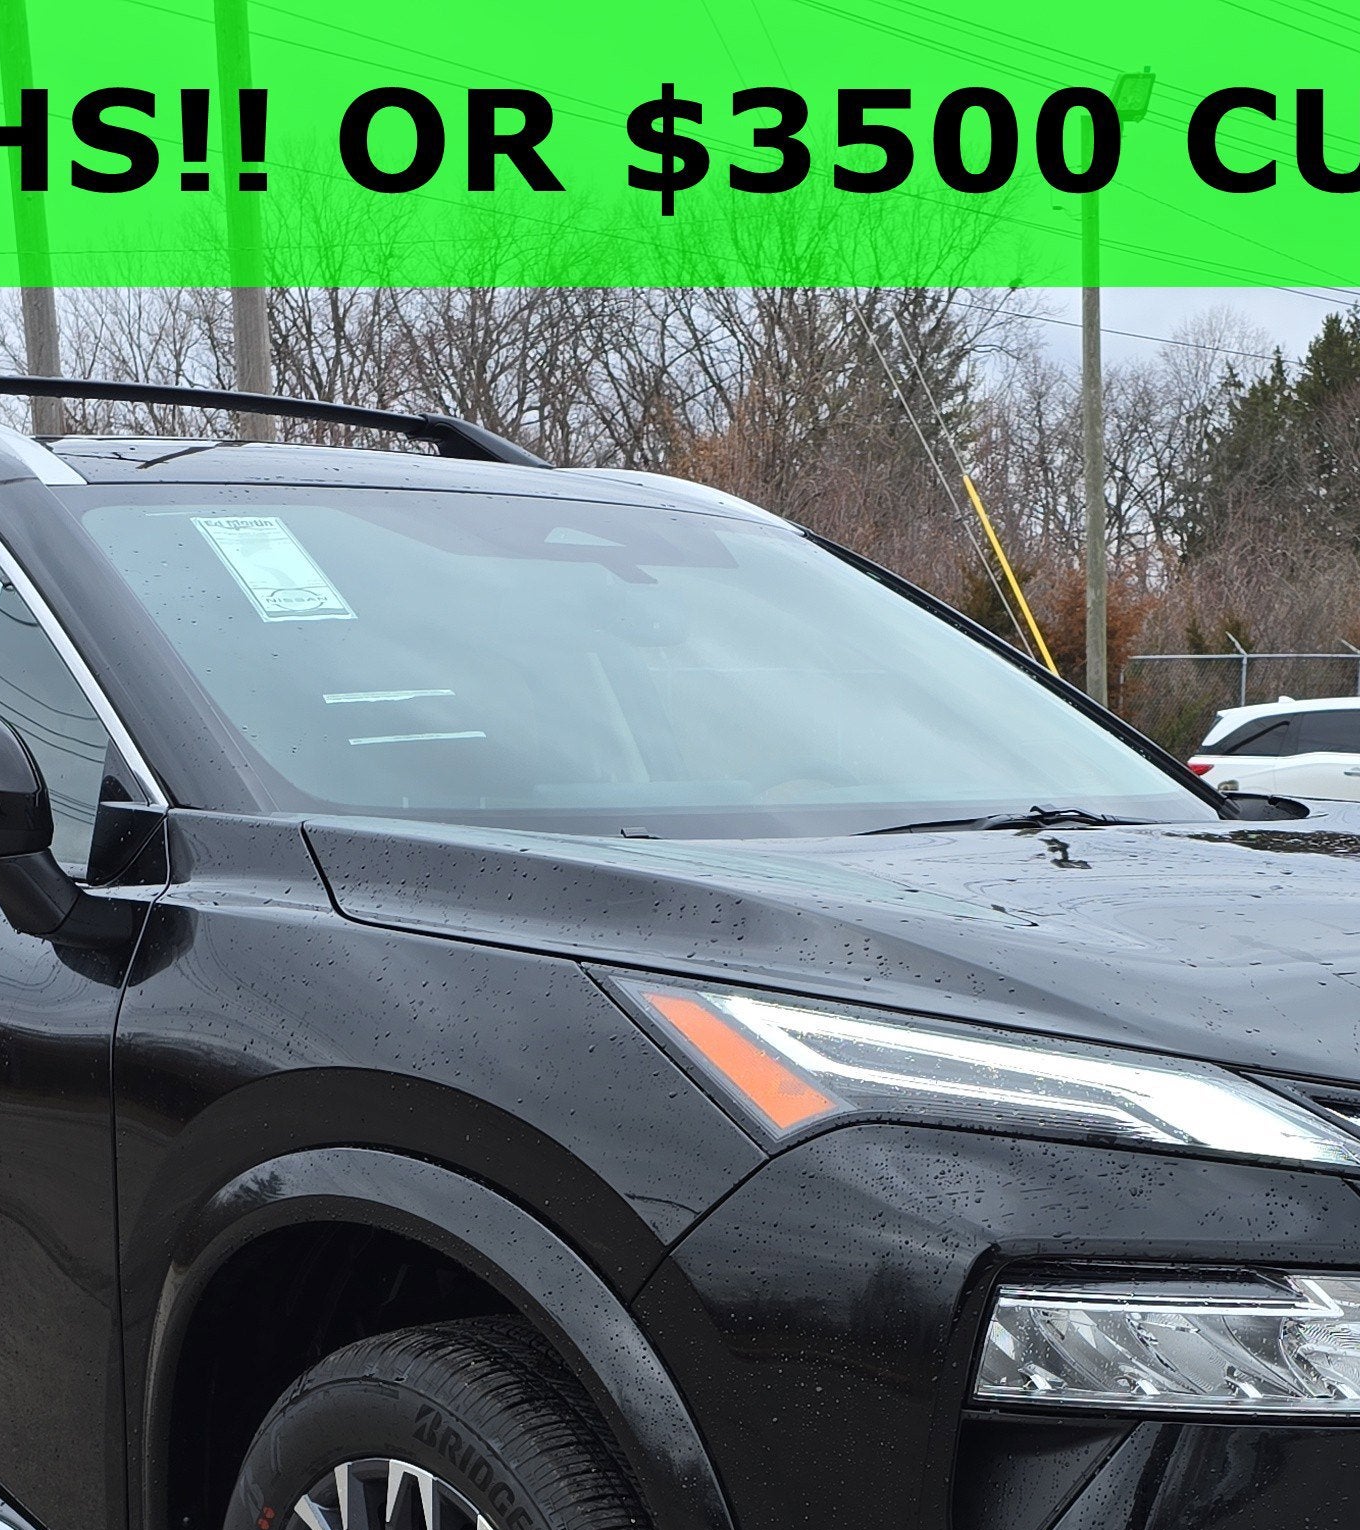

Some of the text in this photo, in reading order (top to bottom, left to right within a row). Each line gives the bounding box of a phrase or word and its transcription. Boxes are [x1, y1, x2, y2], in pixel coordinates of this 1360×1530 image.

[204, 518, 274, 530] Ed Martin
[266, 596, 328, 604] NISSAN
